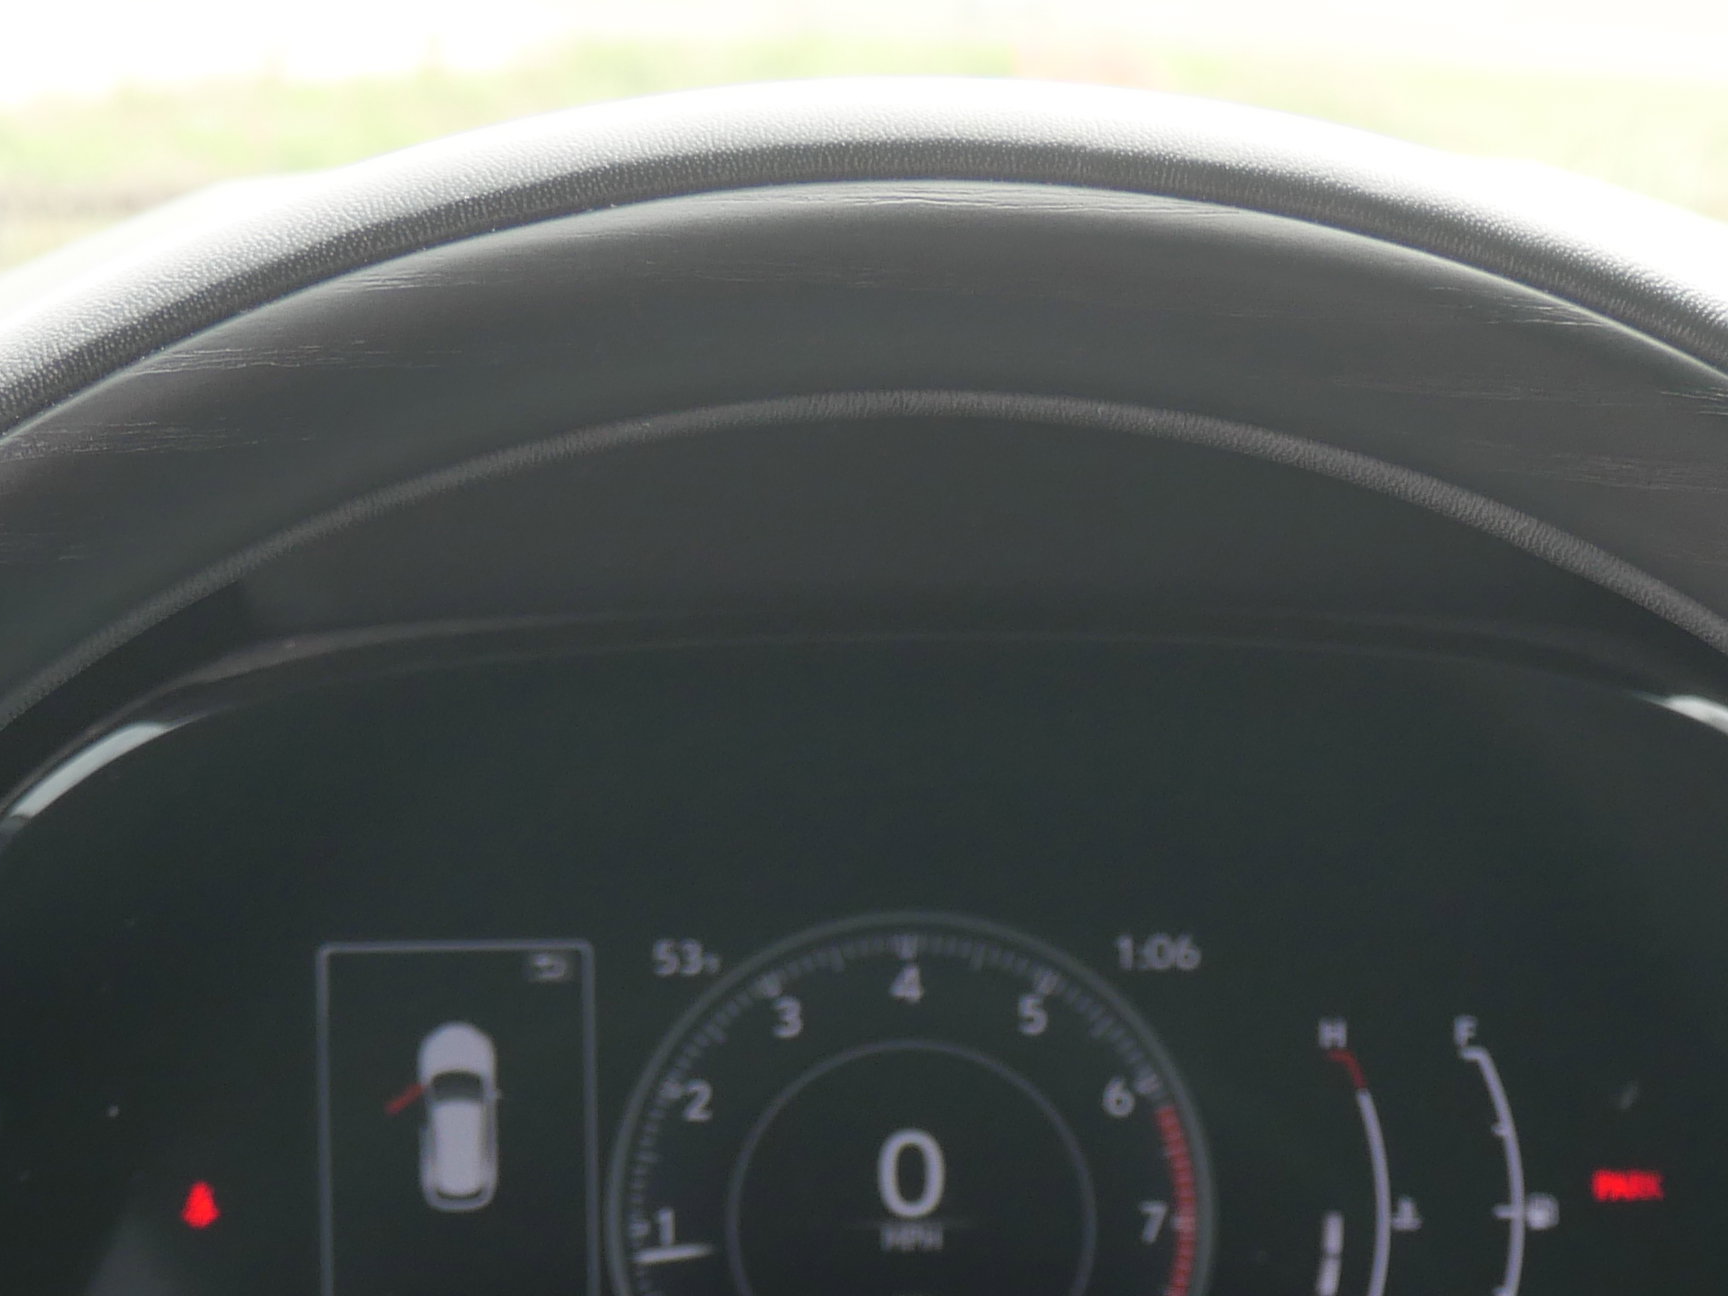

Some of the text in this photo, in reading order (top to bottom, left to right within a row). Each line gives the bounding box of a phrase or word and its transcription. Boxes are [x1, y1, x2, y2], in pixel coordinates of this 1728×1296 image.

[1117, 933, 1202, 970] 1:06
[890, 965, 923, 1001] 4
[773, 995, 803, 1038] 3
[1017, 993, 1048, 1036] 5
[1320, 1018, 1347, 1048] H
[1453, 1015, 1478, 1047] F
[683, 1080, 711, 1121] 2
[1103, 1081, 1135, 1117] 6
[878, 1128, 945, 1219] 0
[657, 1208, 675, 1244] 1
[1141, 1204, 1166, 1244] 7
